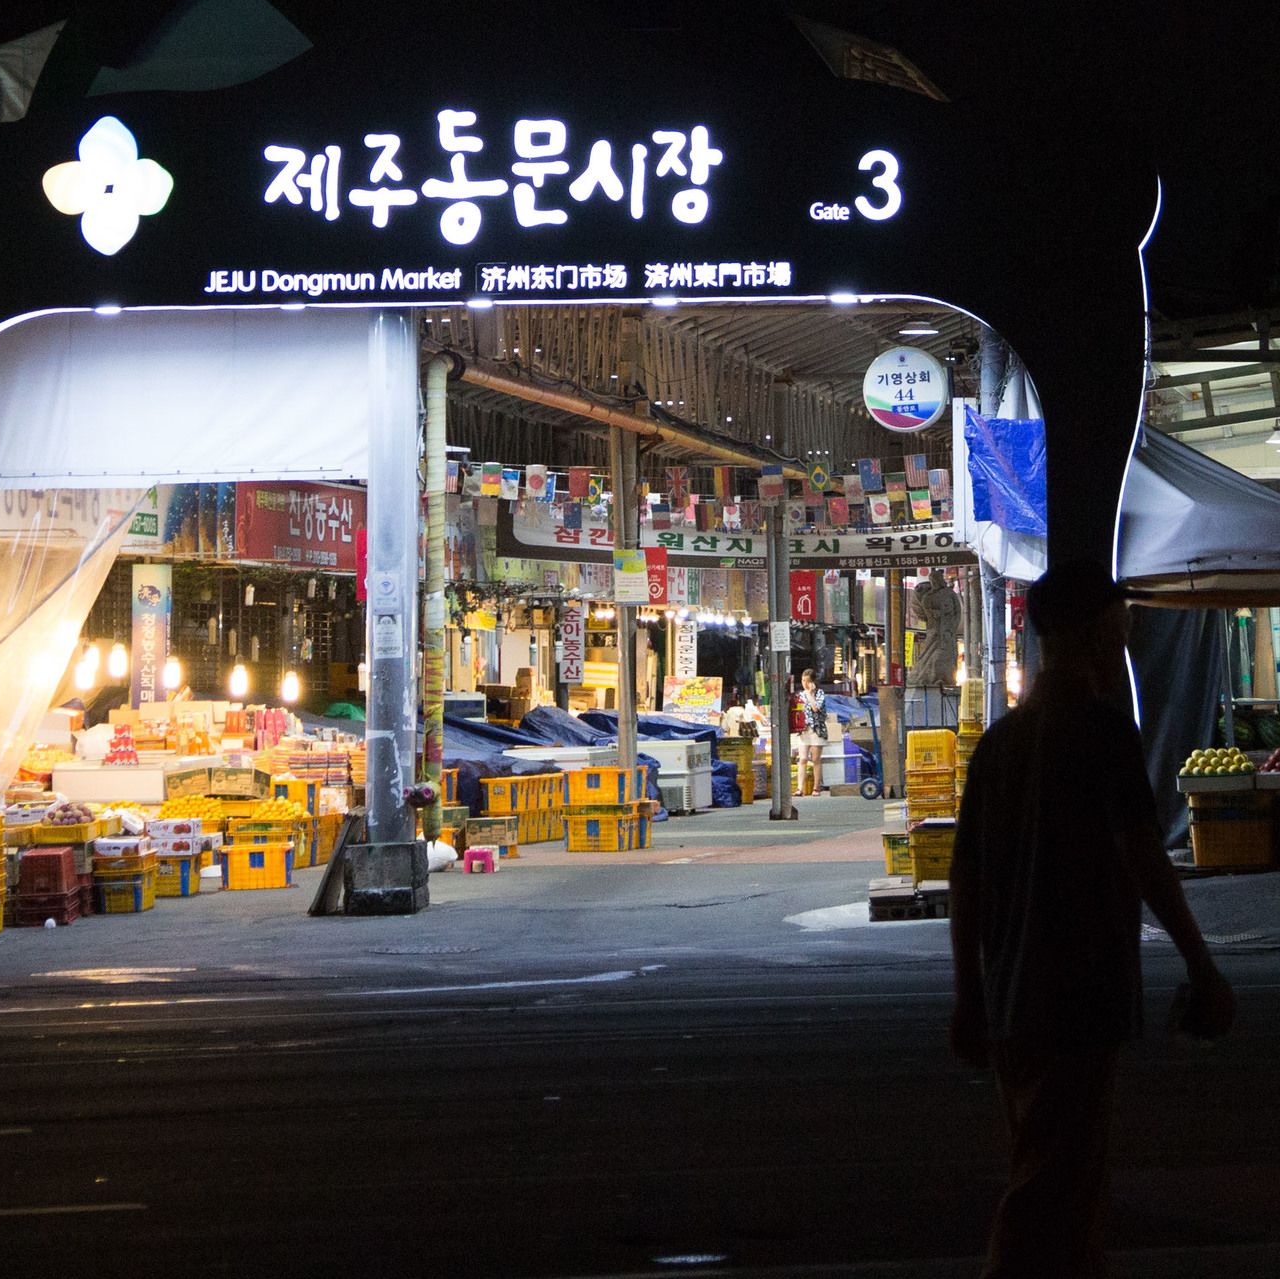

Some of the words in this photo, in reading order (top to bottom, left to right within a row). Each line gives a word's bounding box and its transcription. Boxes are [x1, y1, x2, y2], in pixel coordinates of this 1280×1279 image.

[263, 108, 724, 246] 제주동문시장
[809, 201, 850, 221] Gate
[854, 149, 902, 221] 3
[204, 270, 256, 294] JEJU
[261, 269, 375, 297] Dongmun
[380, 266, 462, 291] Market
[877, 370, 931, 386] 기영상회
[894, 388, 915, 401] 44
[288, 489, 353, 543] 진성농수산
[656, 532, 754, 554] 원산지
[839, 557, 891, 568] 부정유통신고
[895, 555, 948, 565] 1588-8112
[563, 607, 581, 680] 순아농수산
